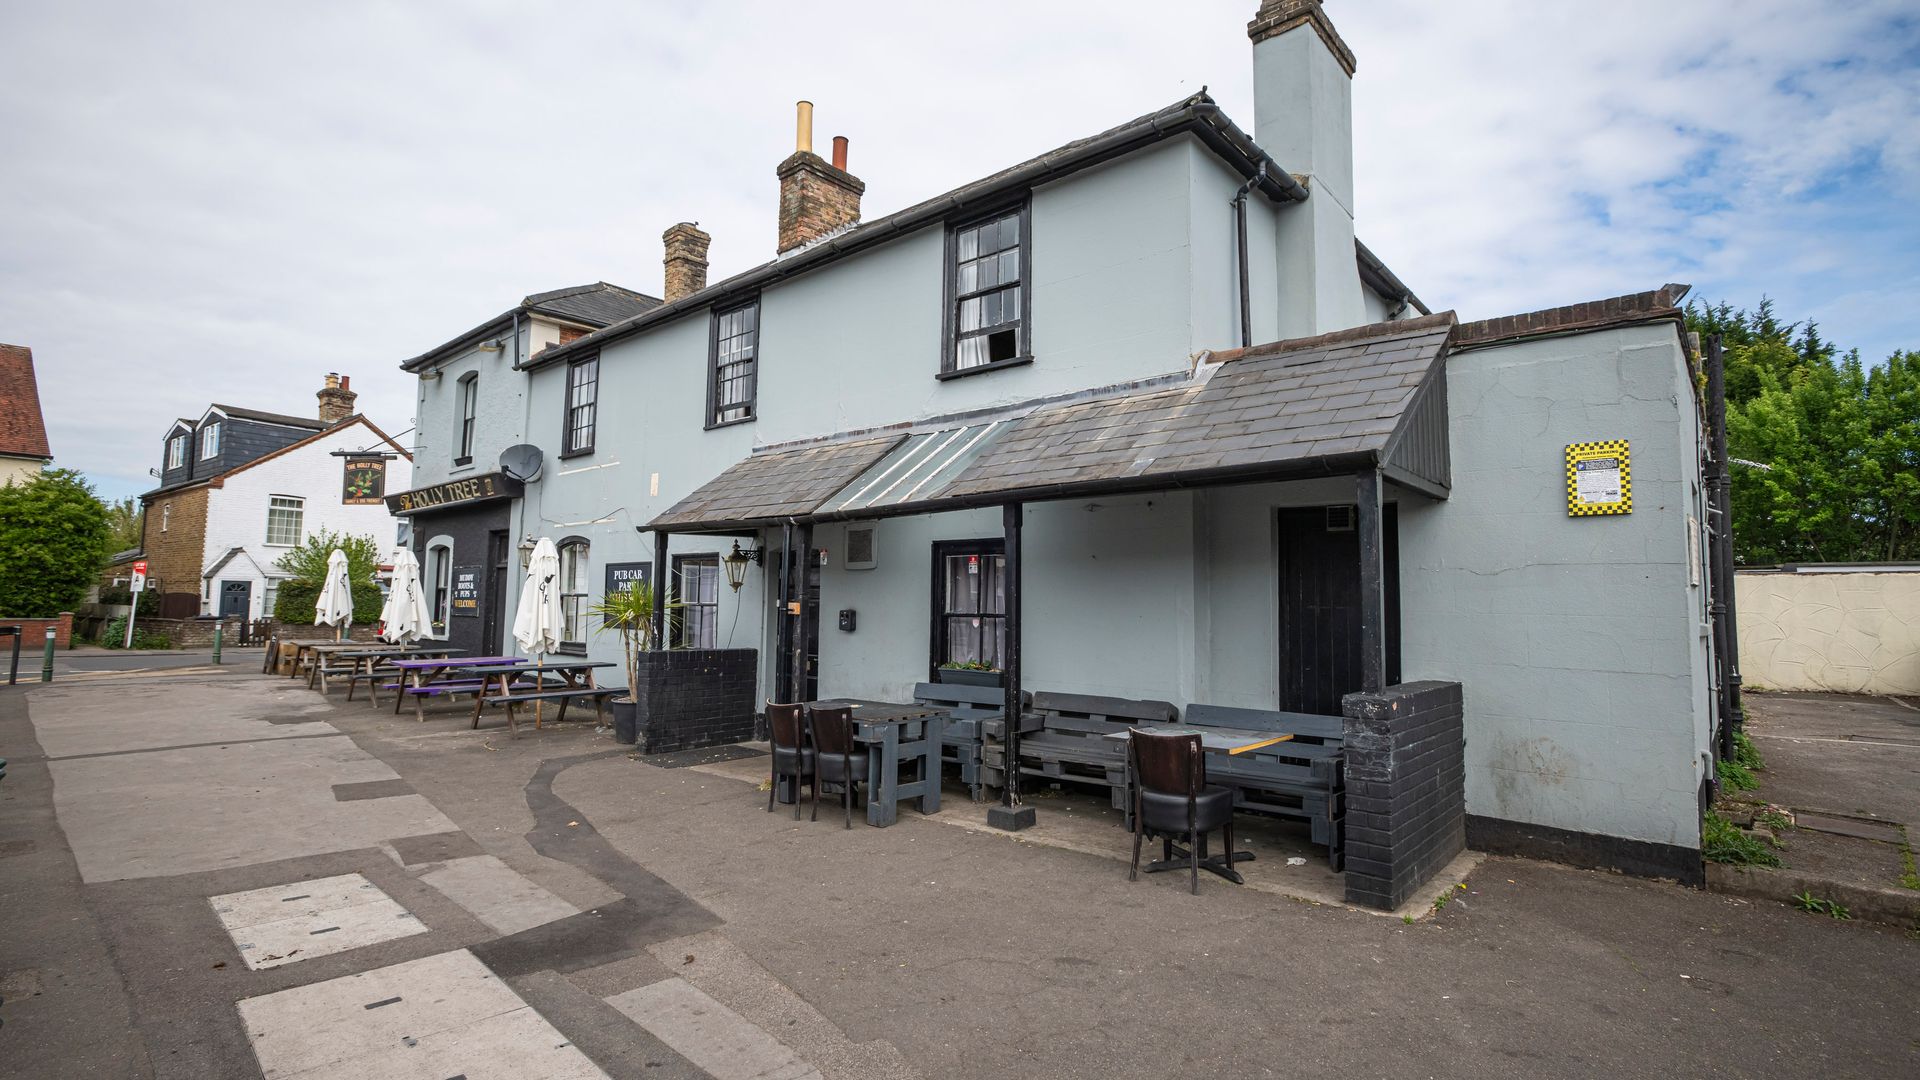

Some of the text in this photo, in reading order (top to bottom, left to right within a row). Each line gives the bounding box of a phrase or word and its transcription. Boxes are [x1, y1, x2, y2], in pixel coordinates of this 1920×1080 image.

[346, 463, 356, 471] THE
[371, 462, 383, 471] TREE
[411, 486, 446, 509] HOLLY
[446, 478, 481, 501] TREE
[459, 574, 474, 582] MUDDY
[613, 569, 643, 580] PUB CAR
[457, 582, 471, 590] BOOTS
[460, 590, 470, 598] PUPS
[454, 599, 477, 608] WELCOME
